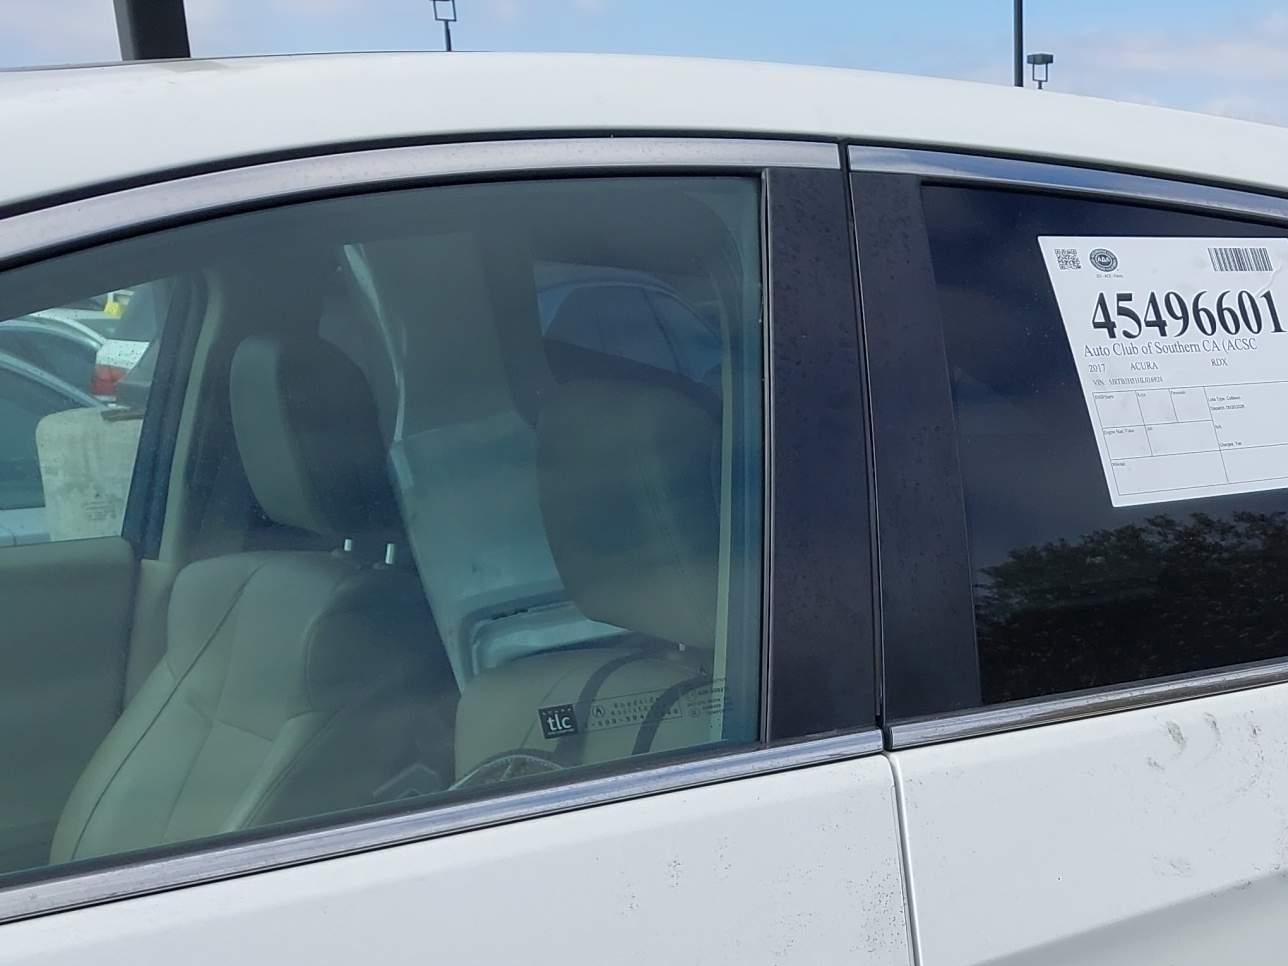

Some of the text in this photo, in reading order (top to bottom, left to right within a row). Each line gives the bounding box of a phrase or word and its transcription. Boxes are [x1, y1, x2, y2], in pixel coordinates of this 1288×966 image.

[1091, 290, 1288, 339] 45496601
[1084, 337, 1258, 357] Auto Club of Southern CA (ACSC
[1088, 358, 1229, 373] 2017 ACURA RDX
